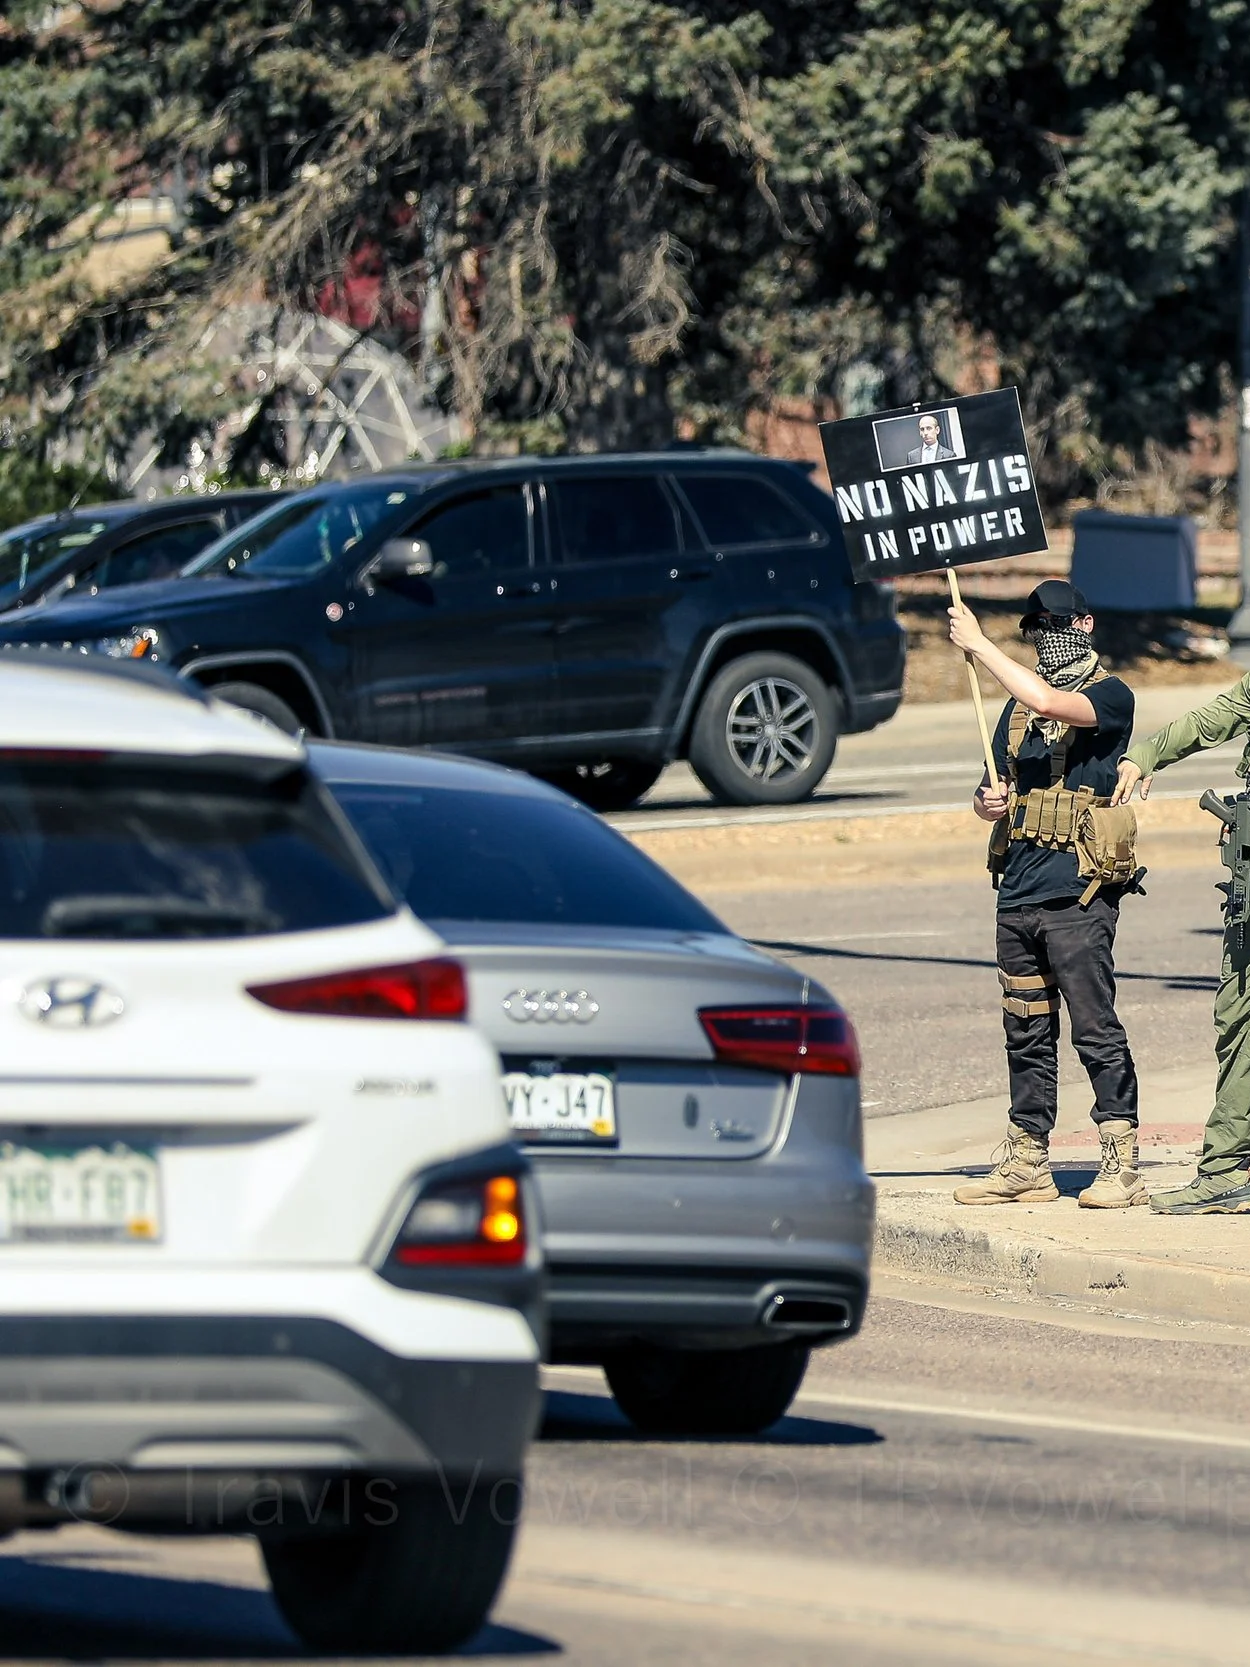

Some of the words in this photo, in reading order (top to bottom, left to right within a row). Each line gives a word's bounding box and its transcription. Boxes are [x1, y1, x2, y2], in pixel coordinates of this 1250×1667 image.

[836, 479, 893, 523] NO
[901, 454, 1031, 512] NAZIS
[864, 529, 899, 562] IN
[908, 506, 1026, 556] POWER
